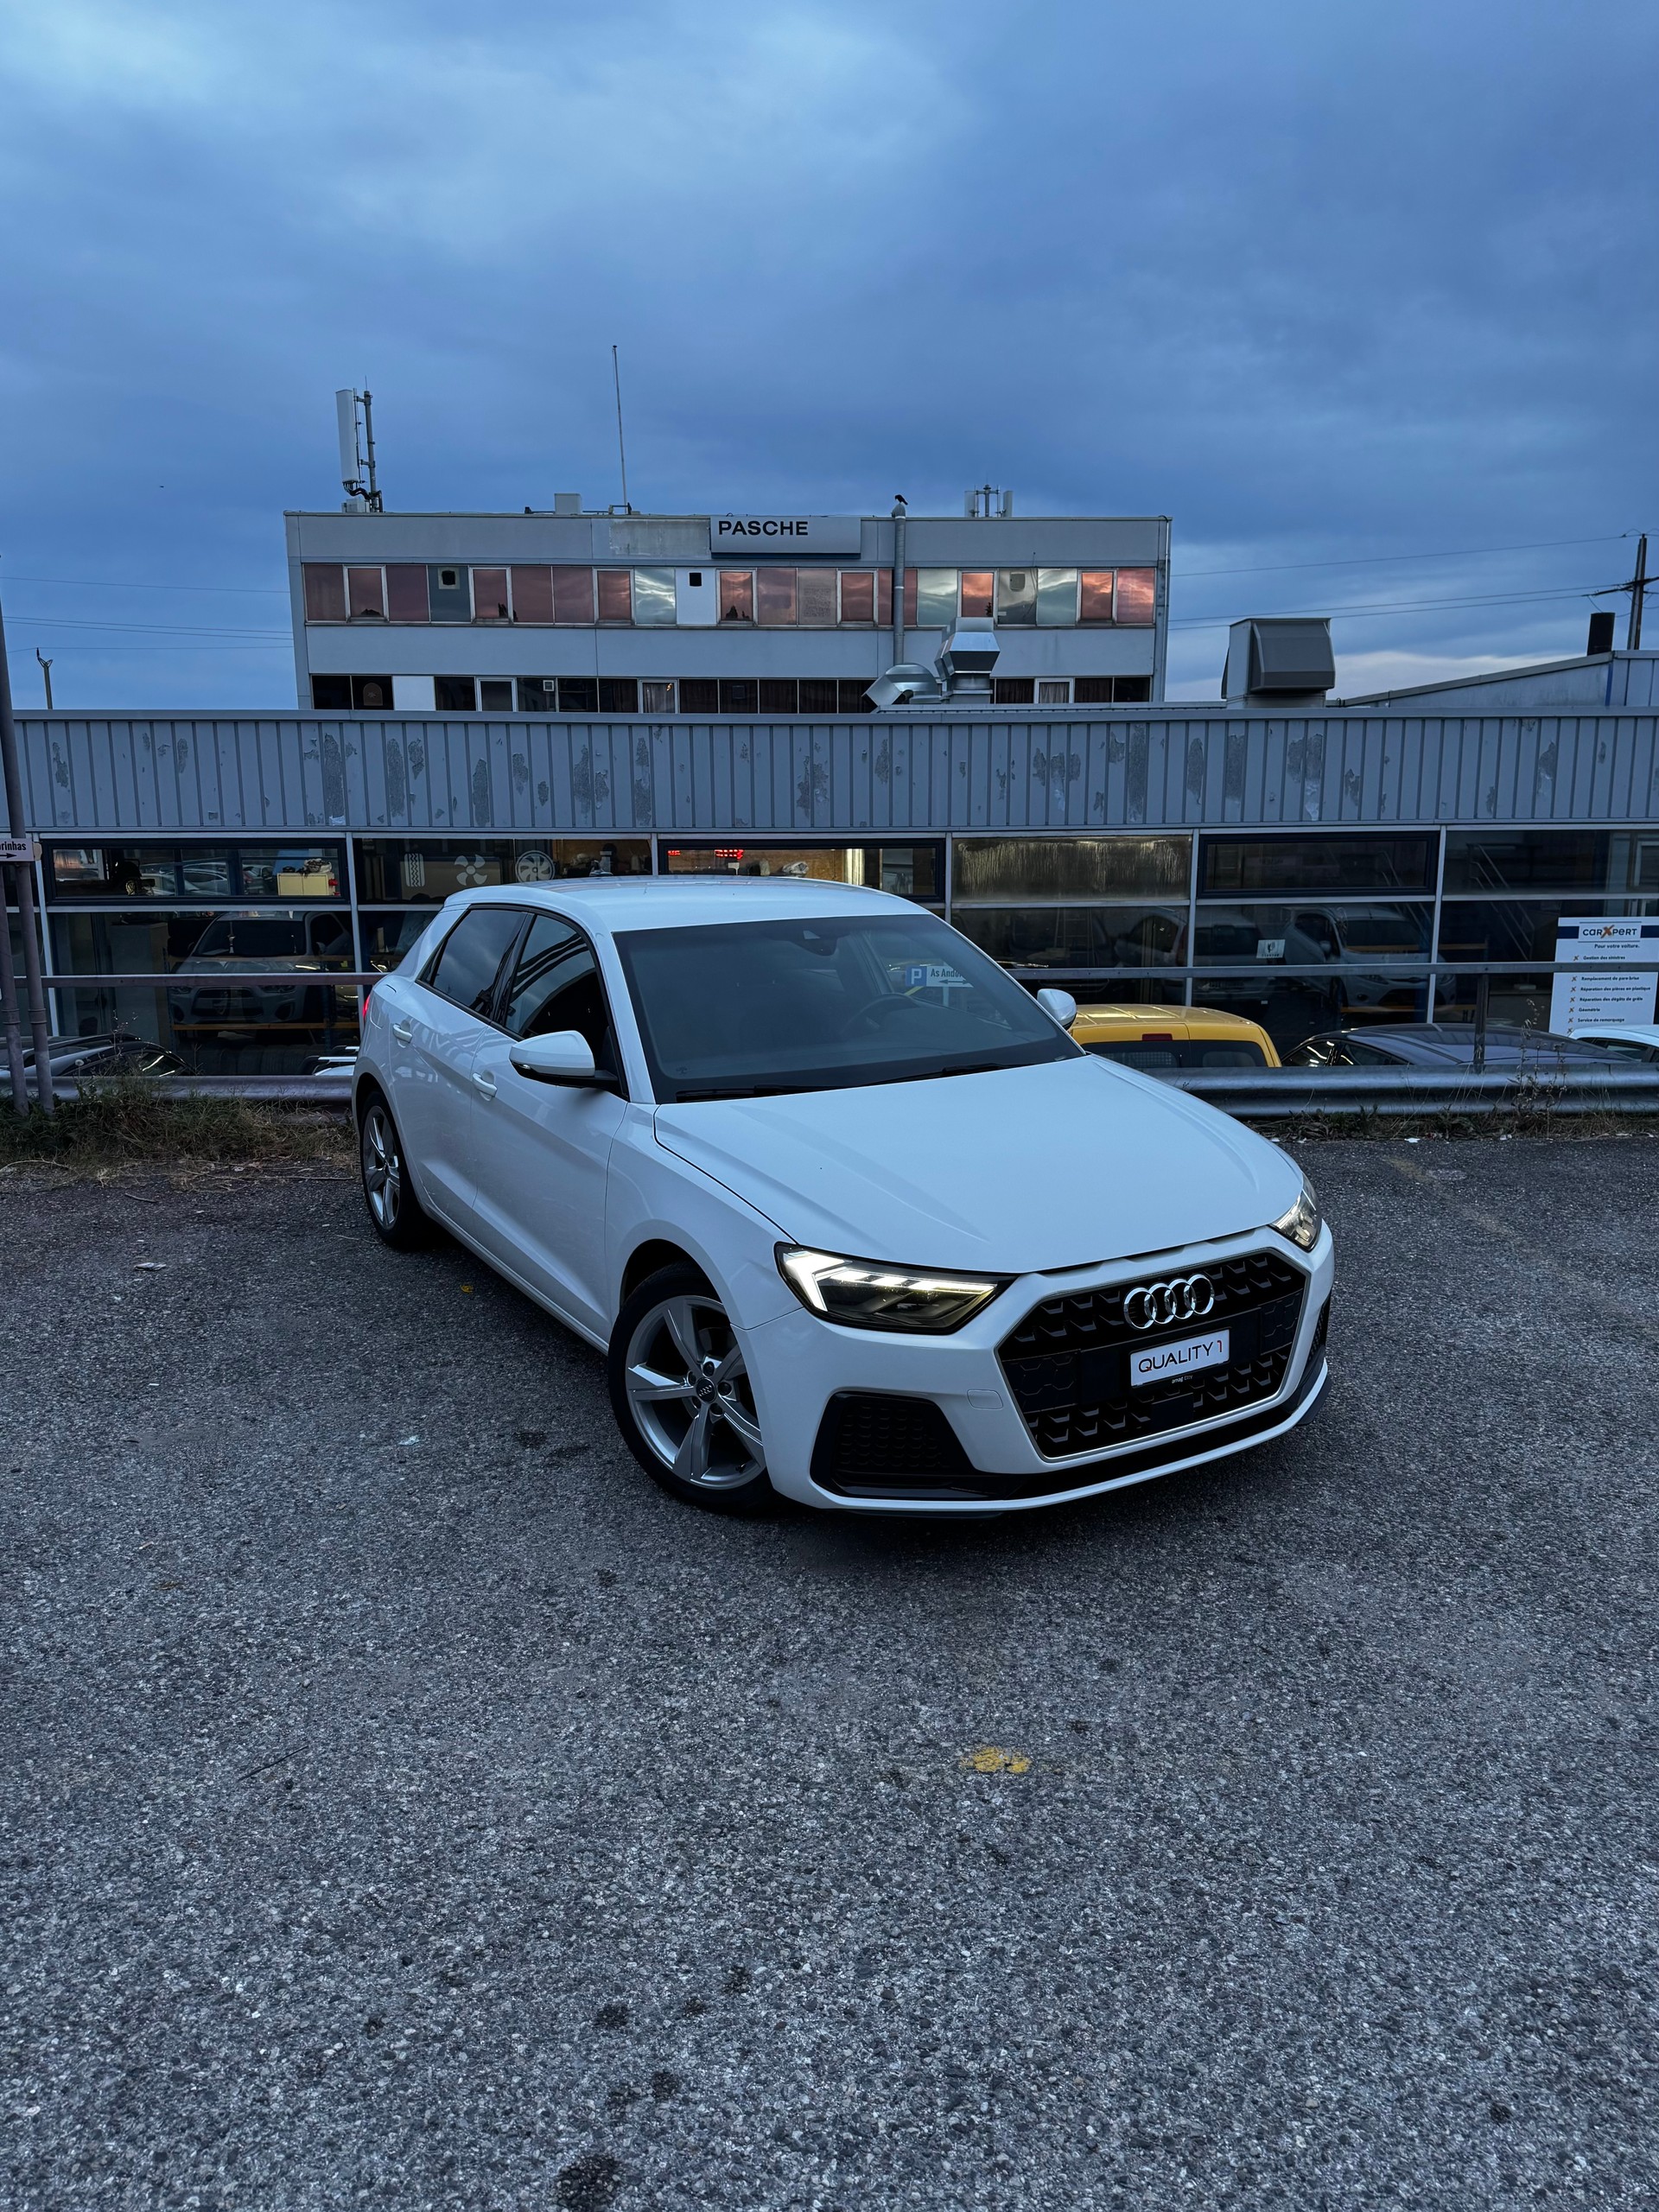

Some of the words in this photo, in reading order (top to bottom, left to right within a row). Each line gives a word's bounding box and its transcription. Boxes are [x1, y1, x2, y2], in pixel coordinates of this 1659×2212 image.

[718, 520, 809, 536] PASCHE
[0, 841, 27, 851] rinhas
[911, 968, 922, 985] P
[931, 968, 940, 977] As
[941, 968, 963, 978] Ando
[1138, 1341, 1214, 1373] QUALITY
[1217, 1340, 1223, 1353] 1
